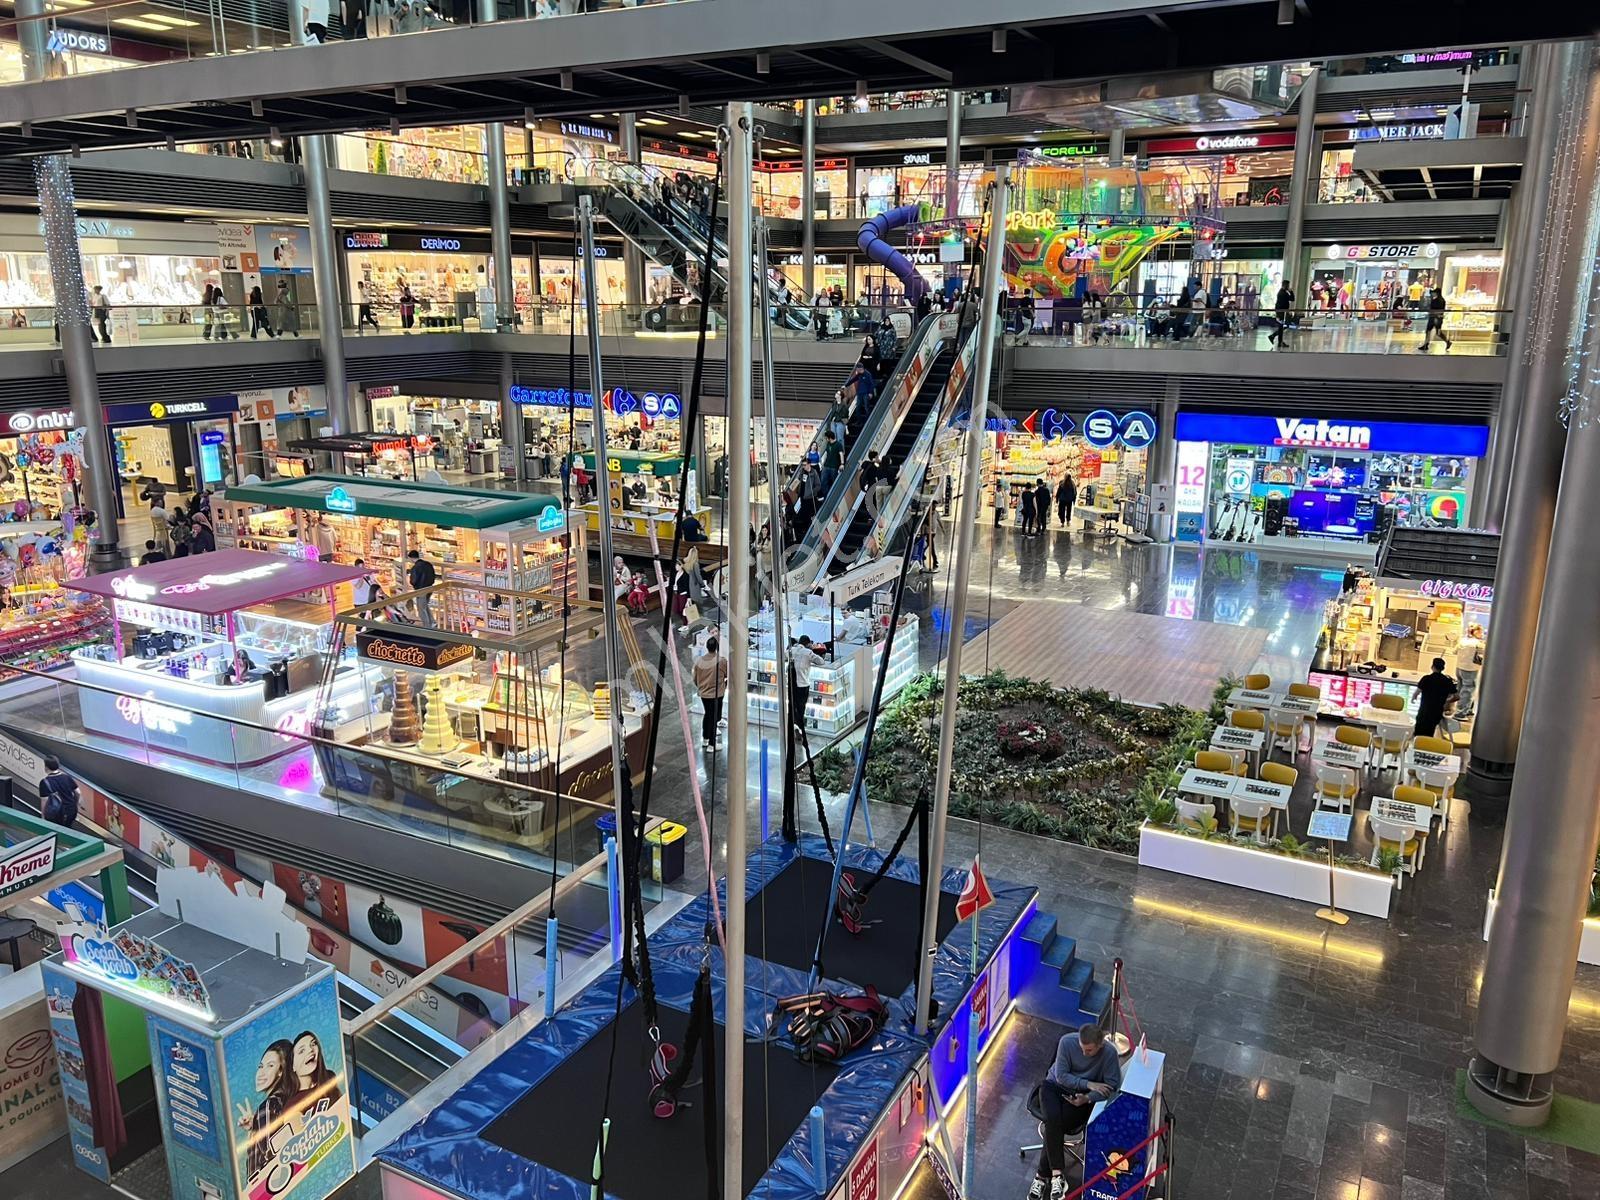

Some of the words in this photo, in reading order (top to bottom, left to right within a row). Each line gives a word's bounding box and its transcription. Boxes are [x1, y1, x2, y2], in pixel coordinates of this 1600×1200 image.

[1209, 136, 1258, 148] vodafone
[1043, 146, 1093, 156] FORELLI
[166, 402, 207, 414] TURKCELL
[1276, 417, 1371, 443] Vatan
[1179, 465, 1205, 486] 12
[1421, 579, 1494, 599] ÇİĞKÖF
